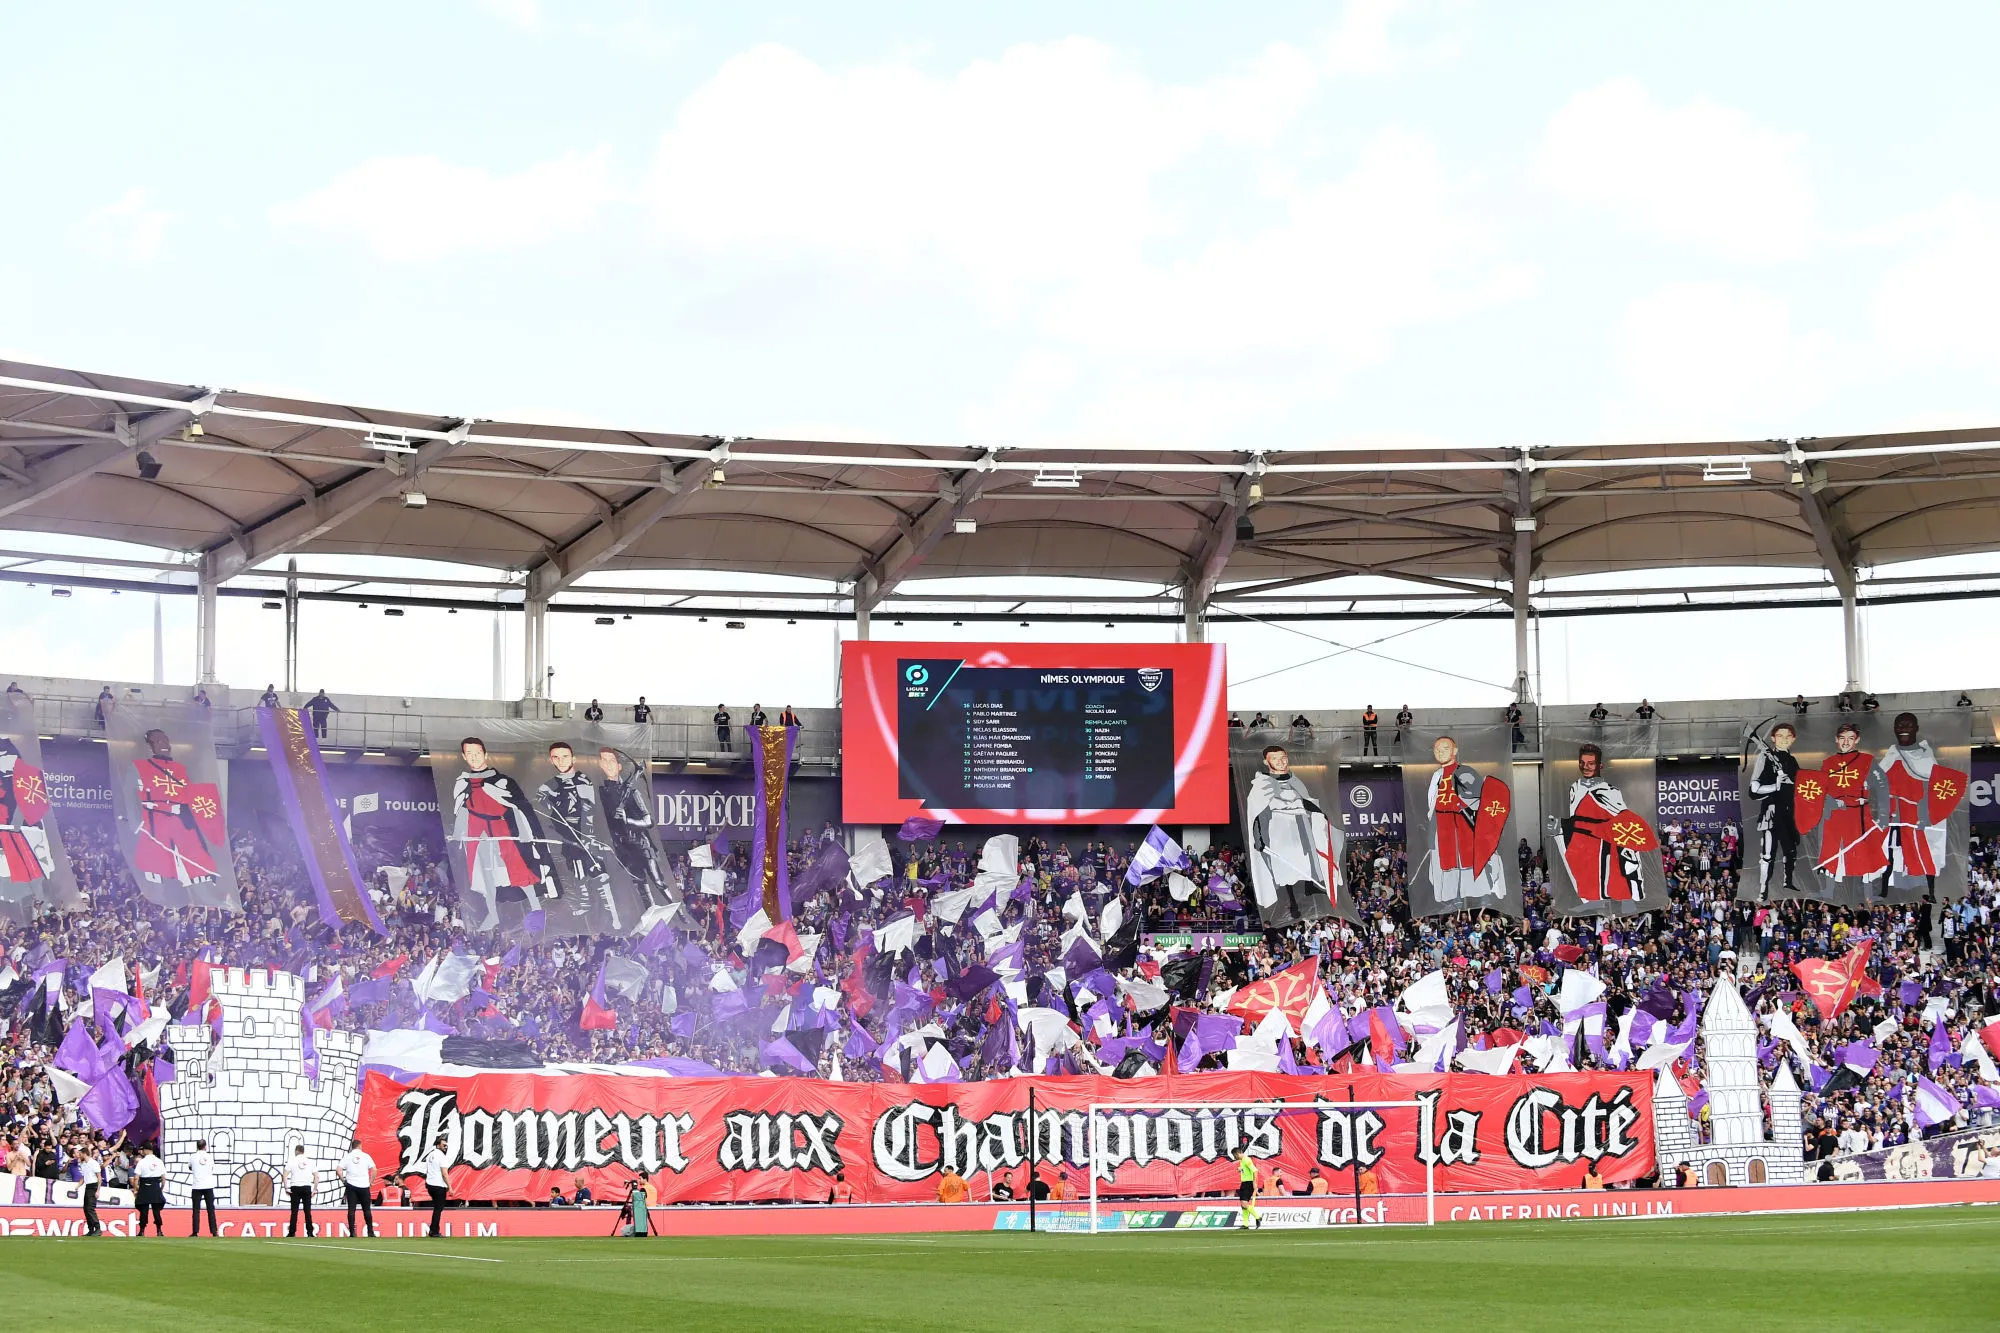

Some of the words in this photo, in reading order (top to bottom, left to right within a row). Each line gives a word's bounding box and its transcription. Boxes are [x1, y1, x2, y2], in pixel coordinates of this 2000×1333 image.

[1040, 674, 1069, 684] NÎMES
[1071, 675, 1125, 684] OLYMPIQUE
[1658, 779, 1720, 791] BANQUE
[48, 784, 113, 801] ccitanie
[1658, 790, 1740, 803] POPULAIRE
[656, 790, 756, 826] DÉPÊCH
[1658, 804, 1716, 815] OCCITANE
[1342, 813, 1352, 825] E
[1359, 812, 1403, 825] BLAN
[1708, 820, 1722, 829] est
[1156, 936, 1191, 945] SORTIE
[398, 1088, 696, 1176] Honneur
[719, 1109, 845, 1175] aux
[872, 1099, 1283, 1184] Champions
[1316, 1093, 1386, 1170] de
[1415, 1087, 1482, 1166] la
[1504, 1085, 1641, 1170] Cité
[1261, 1210, 1313, 1224] newrest
[1450, 1203, 1581, 1221] CATERING
[1179, 1213, 1230, 1227] BKT
